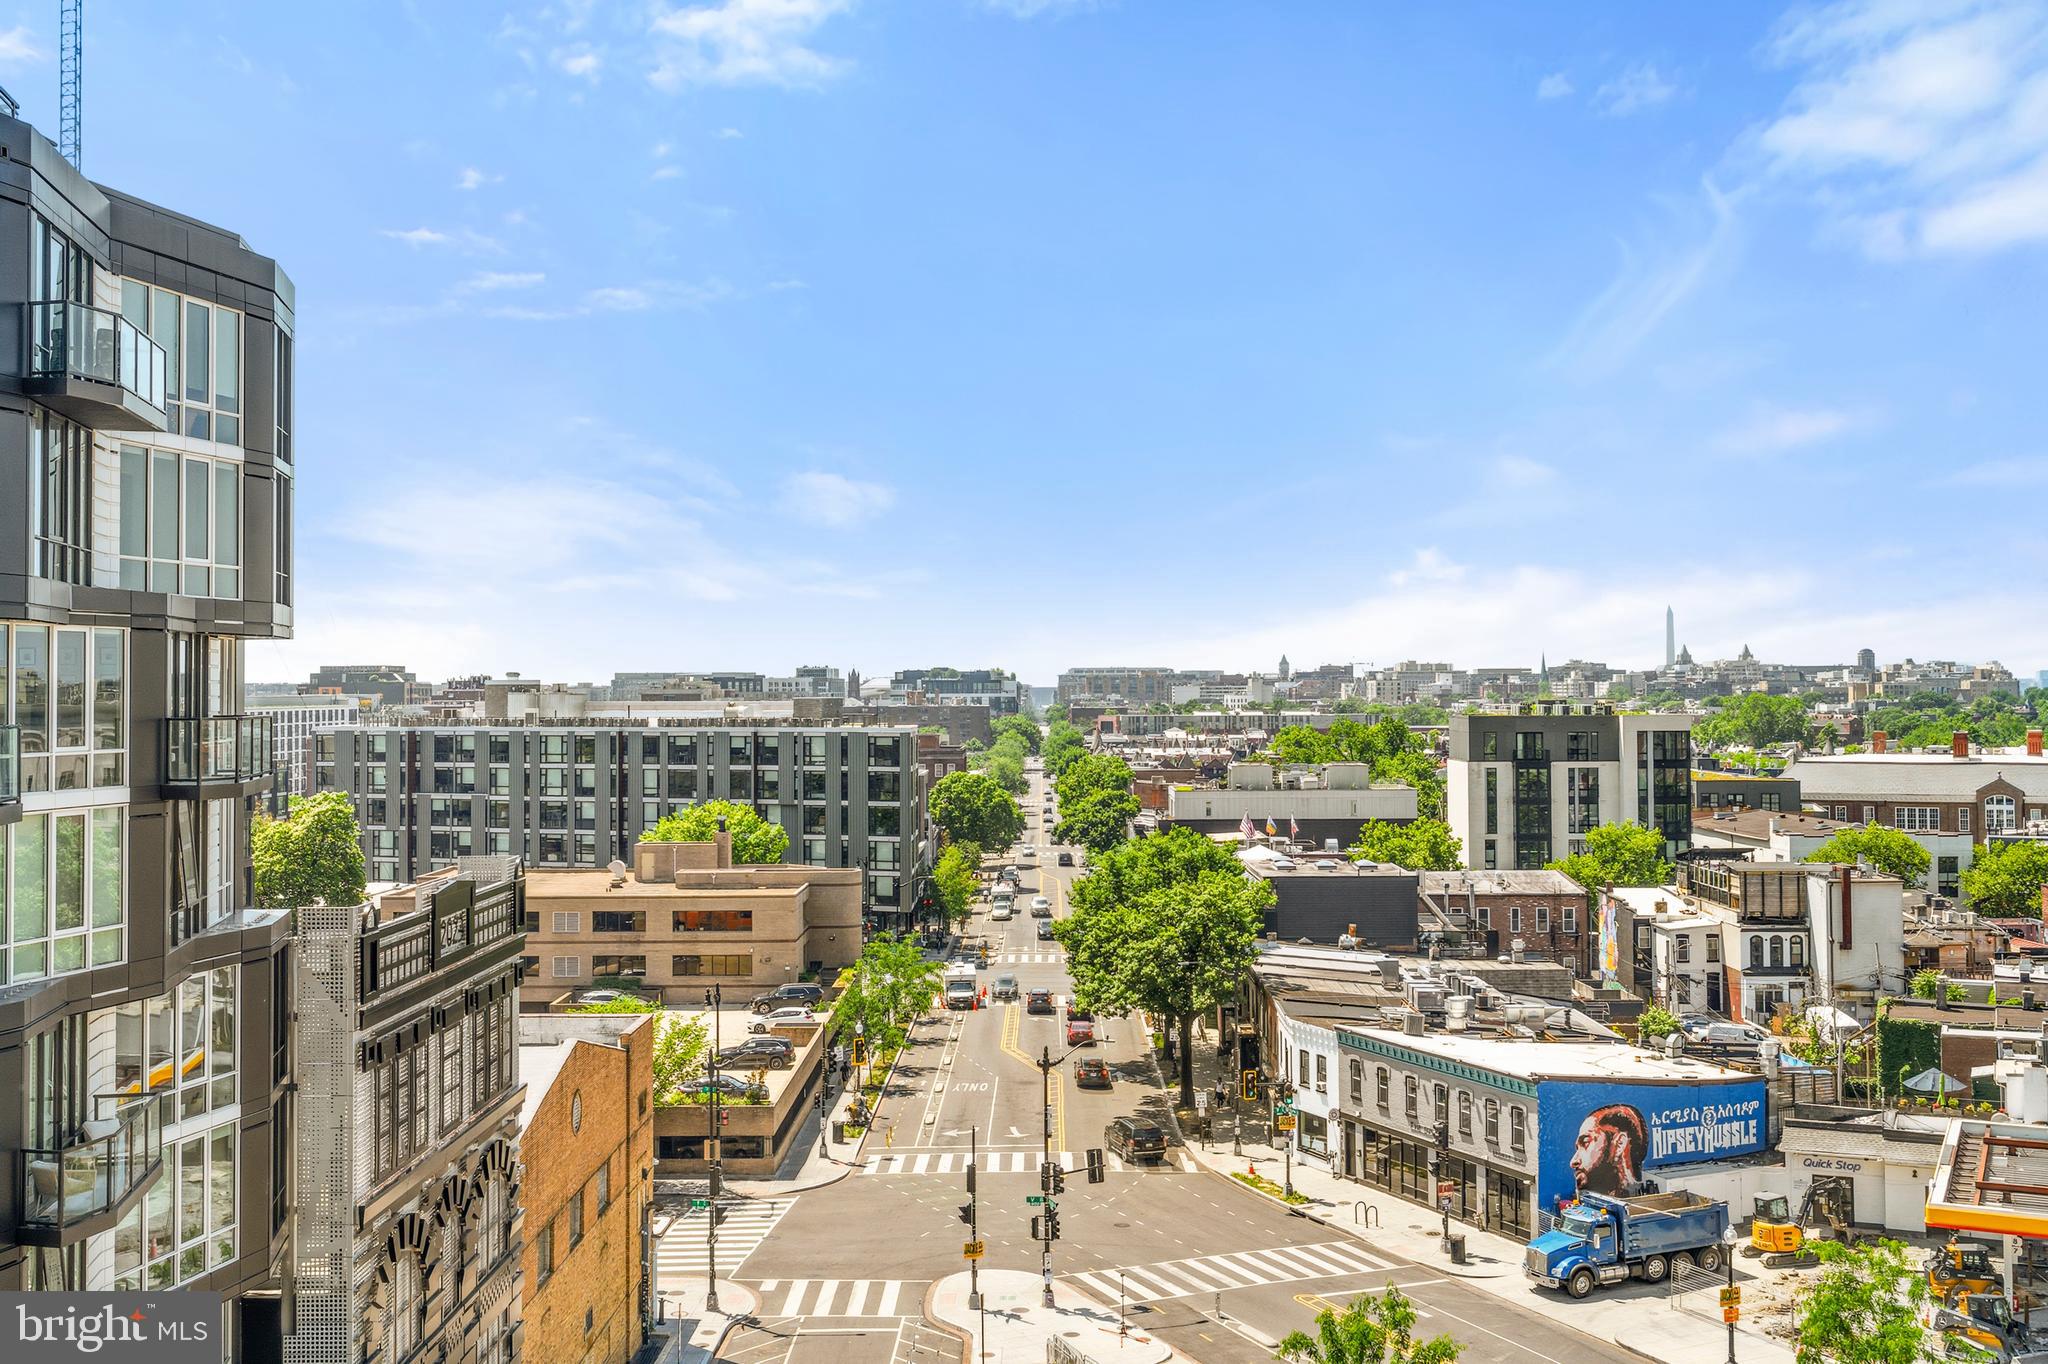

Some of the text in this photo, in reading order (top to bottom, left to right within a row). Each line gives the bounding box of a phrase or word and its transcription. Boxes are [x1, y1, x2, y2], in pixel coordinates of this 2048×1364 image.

[951, 1082, 988, 1092] ONLY
[1803, 1158, 1862, 1172] Quick Stop
